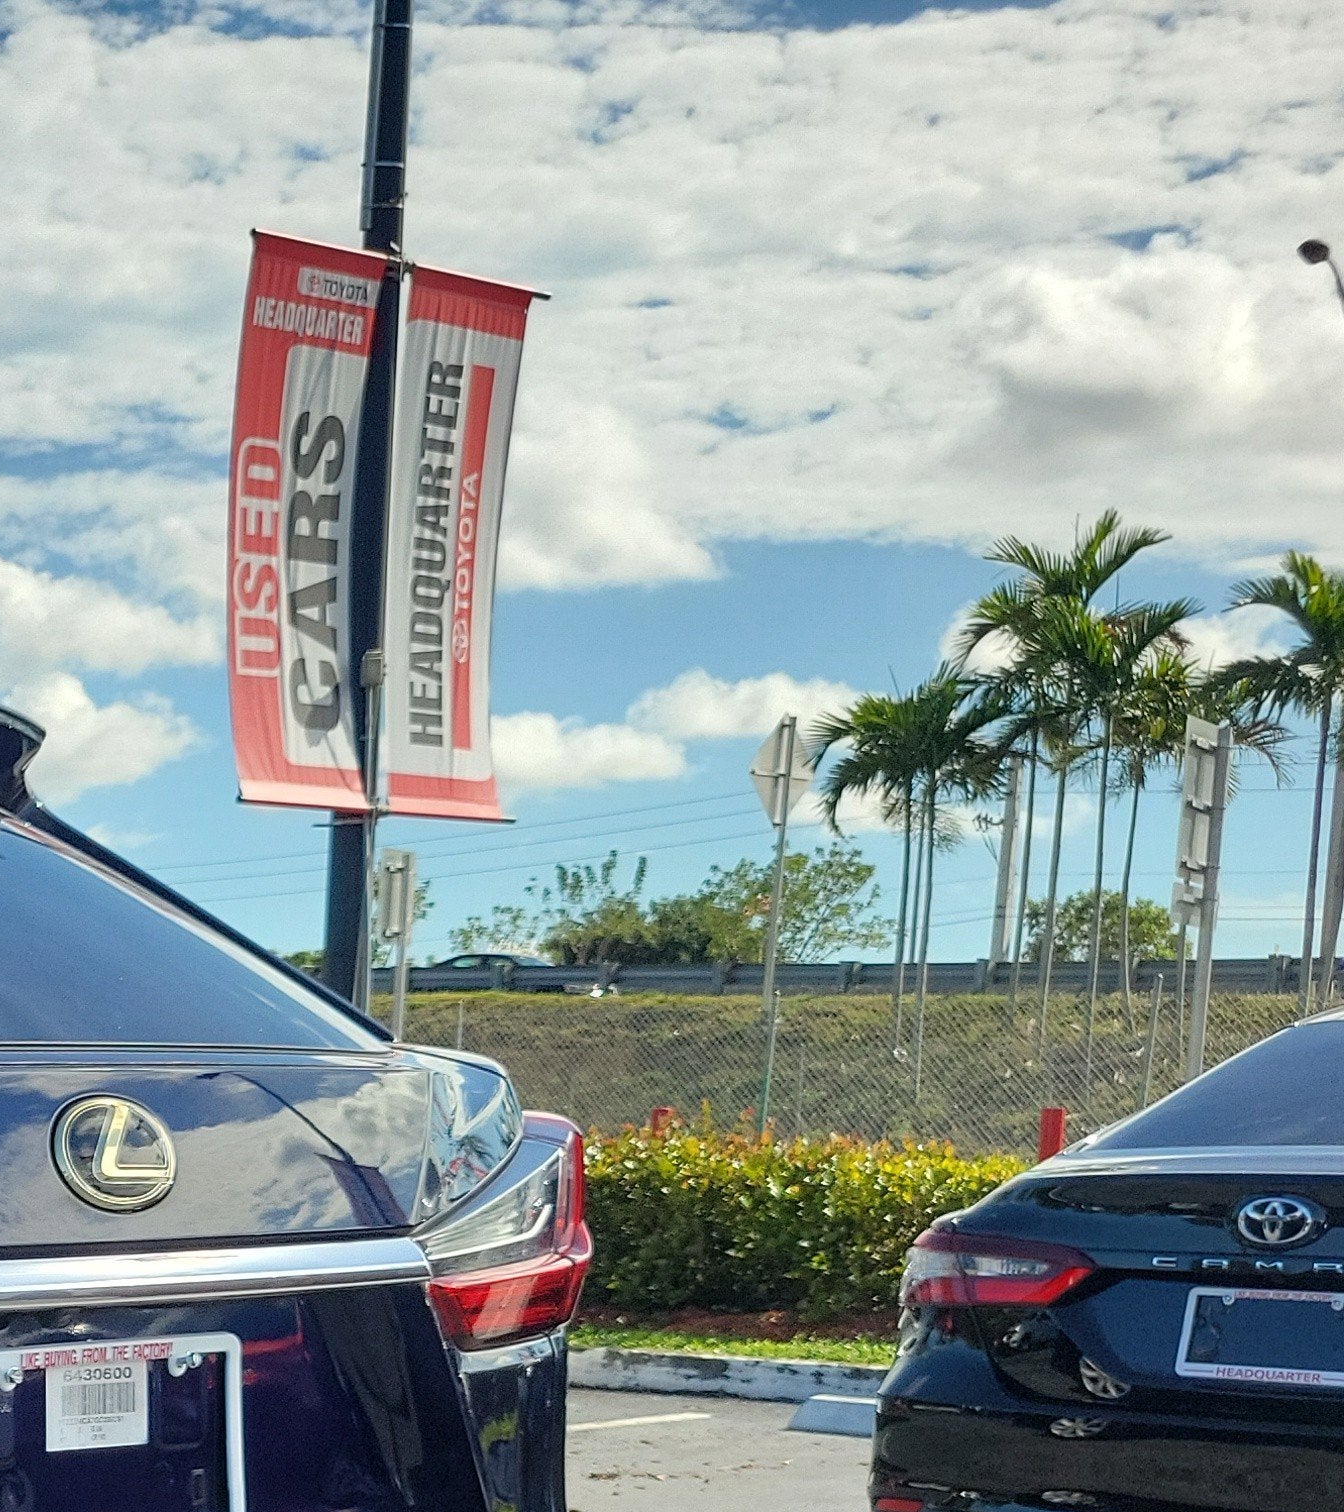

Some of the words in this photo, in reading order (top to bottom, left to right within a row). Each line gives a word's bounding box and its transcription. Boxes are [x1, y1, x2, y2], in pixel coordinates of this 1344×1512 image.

[253, 295, 365, 345] HEADQUARTER
[323, 279, 368, 301] TOYOTA
[234, 436, 281, 678] USED
[287, 410, 345, 734] CARS
[408, 359, 465, 748] HEADQUARTER
[454, 472, 479, 621] TOYOTA
[20, 1352, 40, 1368] LIKE
[44, 1349, 76, 1367] BUYING
[82, 1346, 107, 1364] FROM
[112, 1345, 129, 1361] THE
[1215, 1366, 1321, 1382] HEADQUARTER
